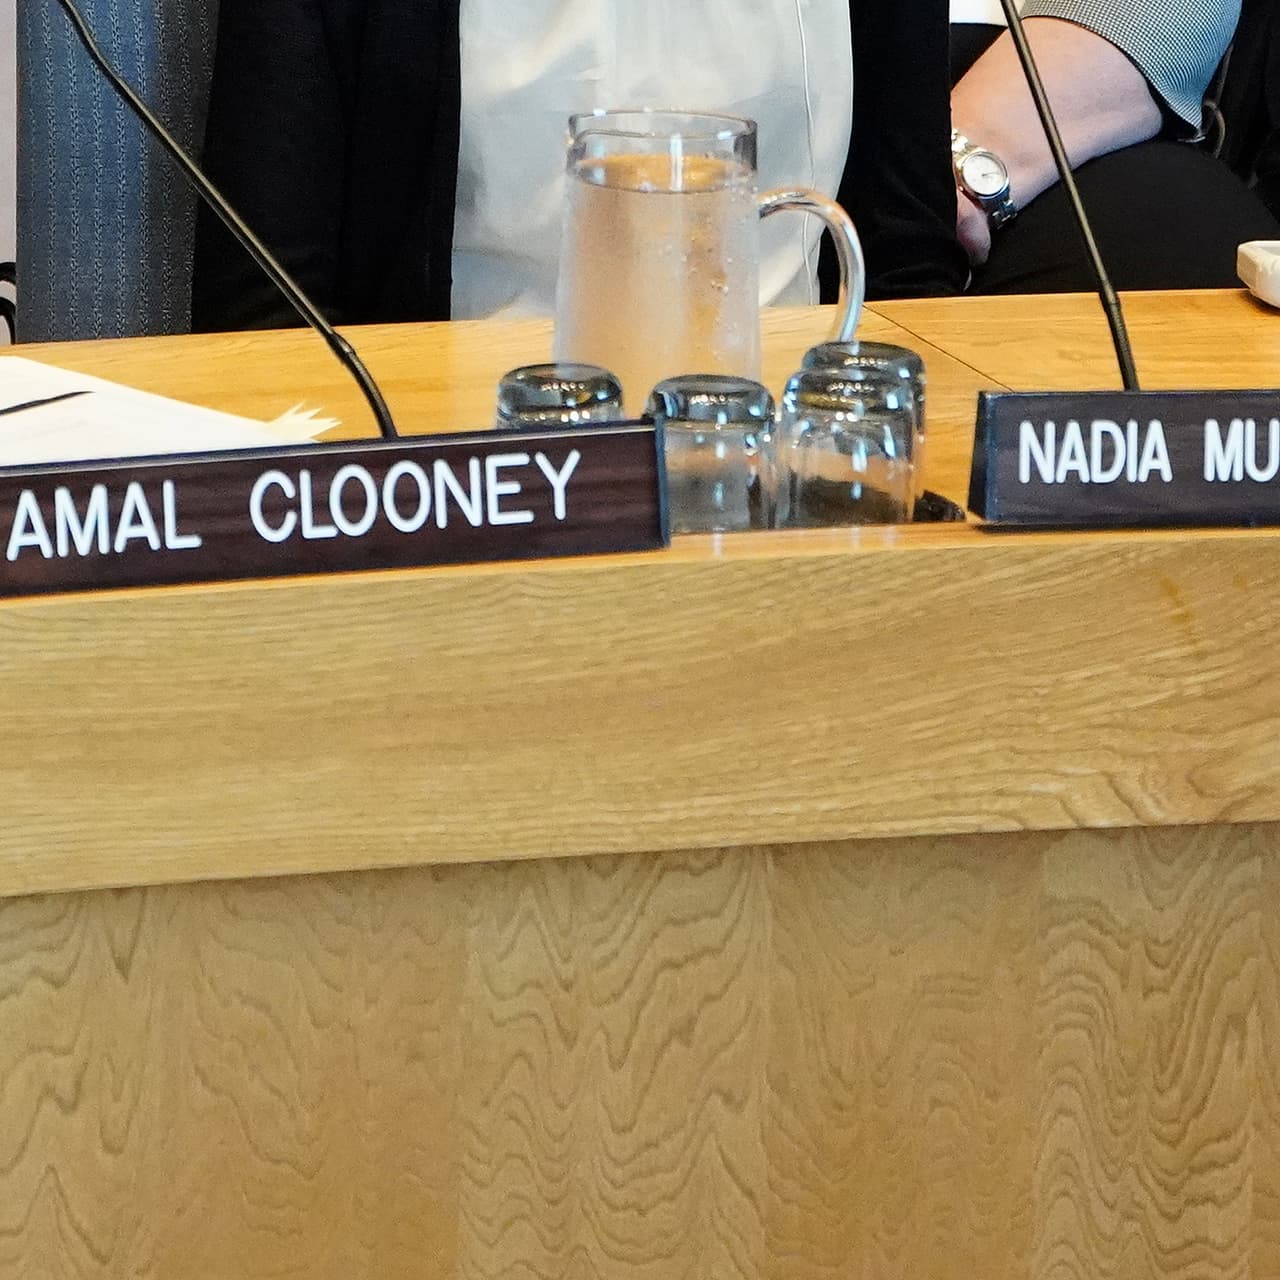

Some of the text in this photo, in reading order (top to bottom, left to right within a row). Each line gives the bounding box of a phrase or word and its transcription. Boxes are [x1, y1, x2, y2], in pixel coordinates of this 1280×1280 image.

[1019, 419, 1173, 484] NADIA
[5, 450, 581, 561] AMAL CLOONEY
